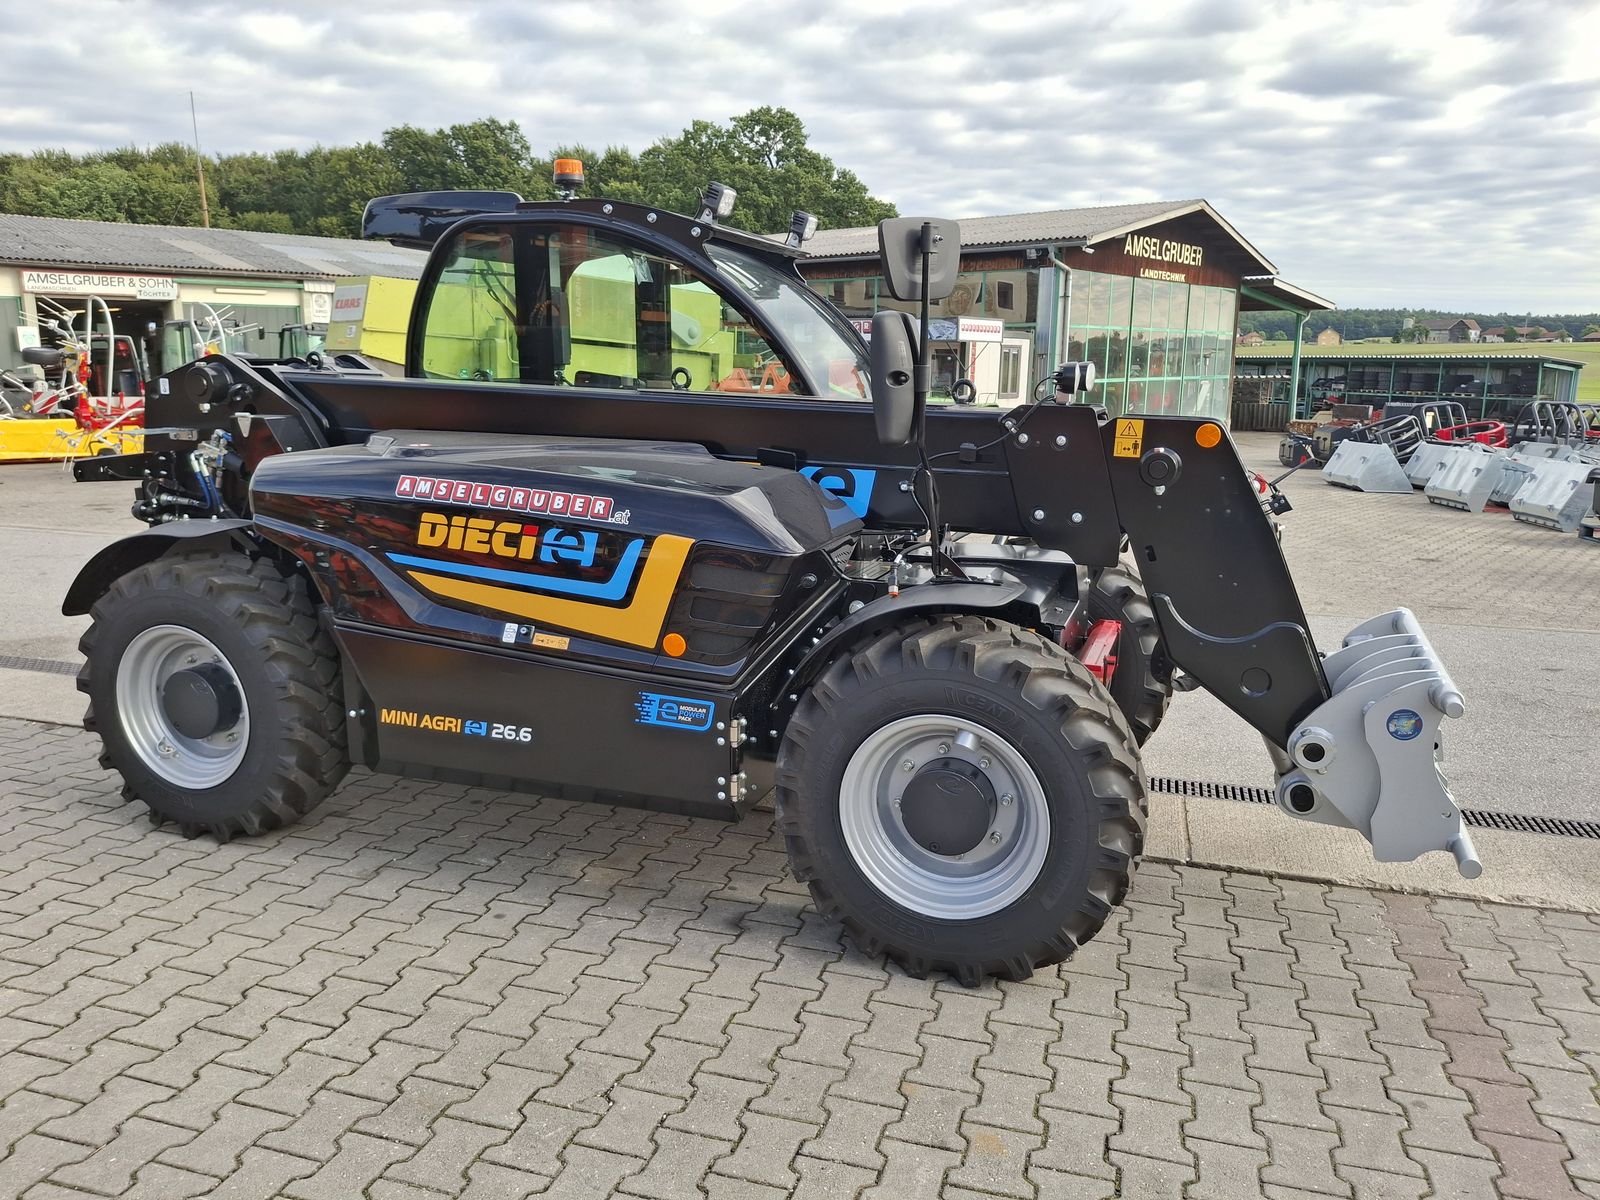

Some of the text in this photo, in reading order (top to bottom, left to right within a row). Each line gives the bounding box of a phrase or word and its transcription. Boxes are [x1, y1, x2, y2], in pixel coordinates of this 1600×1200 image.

[1123, 233, 1203, 267] AMSELGRUBER
[27, 272, 174, 289] AMSELGRUBER & SOHN
[1140, 267, 1186, 283] LANDTECHNIK
[335, 297, 362, 309] CLAAS
[678, 710, 705, 719] POWER
[679, 705, 707, 714] MODULAR
[380, 708, 418, 727] MINI
[419, 714, 462, 733] AGRI
[491, 723, 533, 742] 26.6
